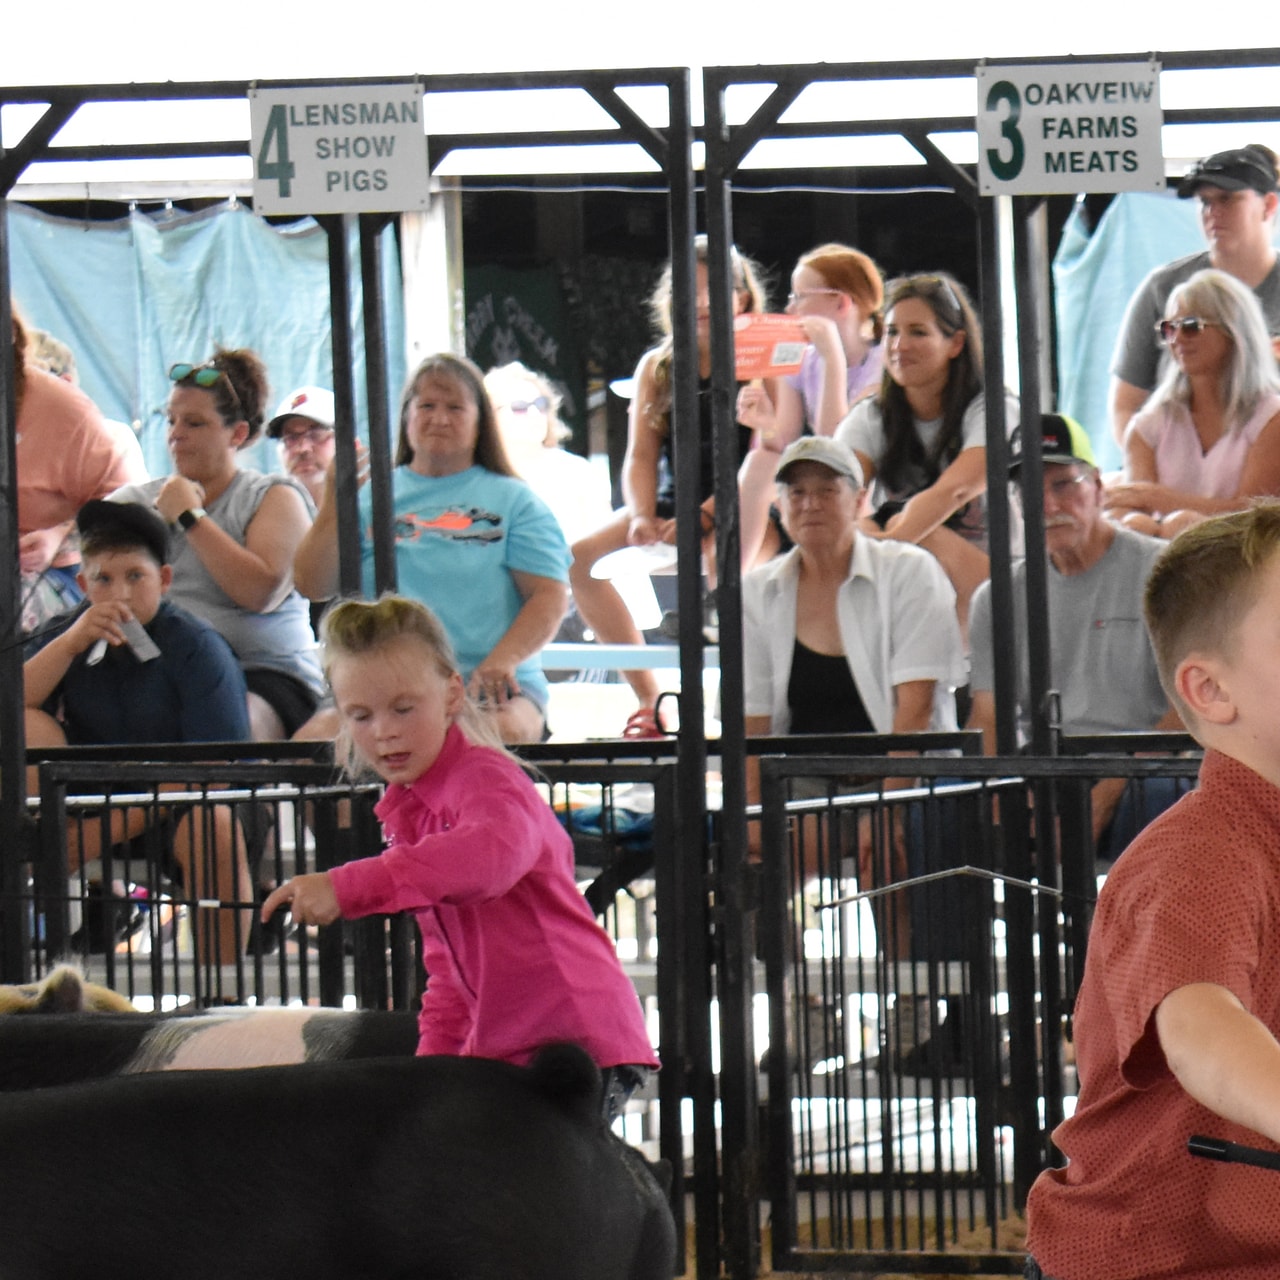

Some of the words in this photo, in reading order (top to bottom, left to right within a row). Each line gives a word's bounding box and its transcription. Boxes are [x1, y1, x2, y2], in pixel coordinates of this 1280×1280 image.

[290, 100, 418, 127] LENSMAN
[985, 80, 1025, 181] 3
[1042, 115, 1138, 140] FARMS
[257, 103, 295, 198] 4
[315, 135, 396, 159] SHOW
[1044, 149, 1139, 174] MEATS
[326, 169, 389, 193] PIGS
